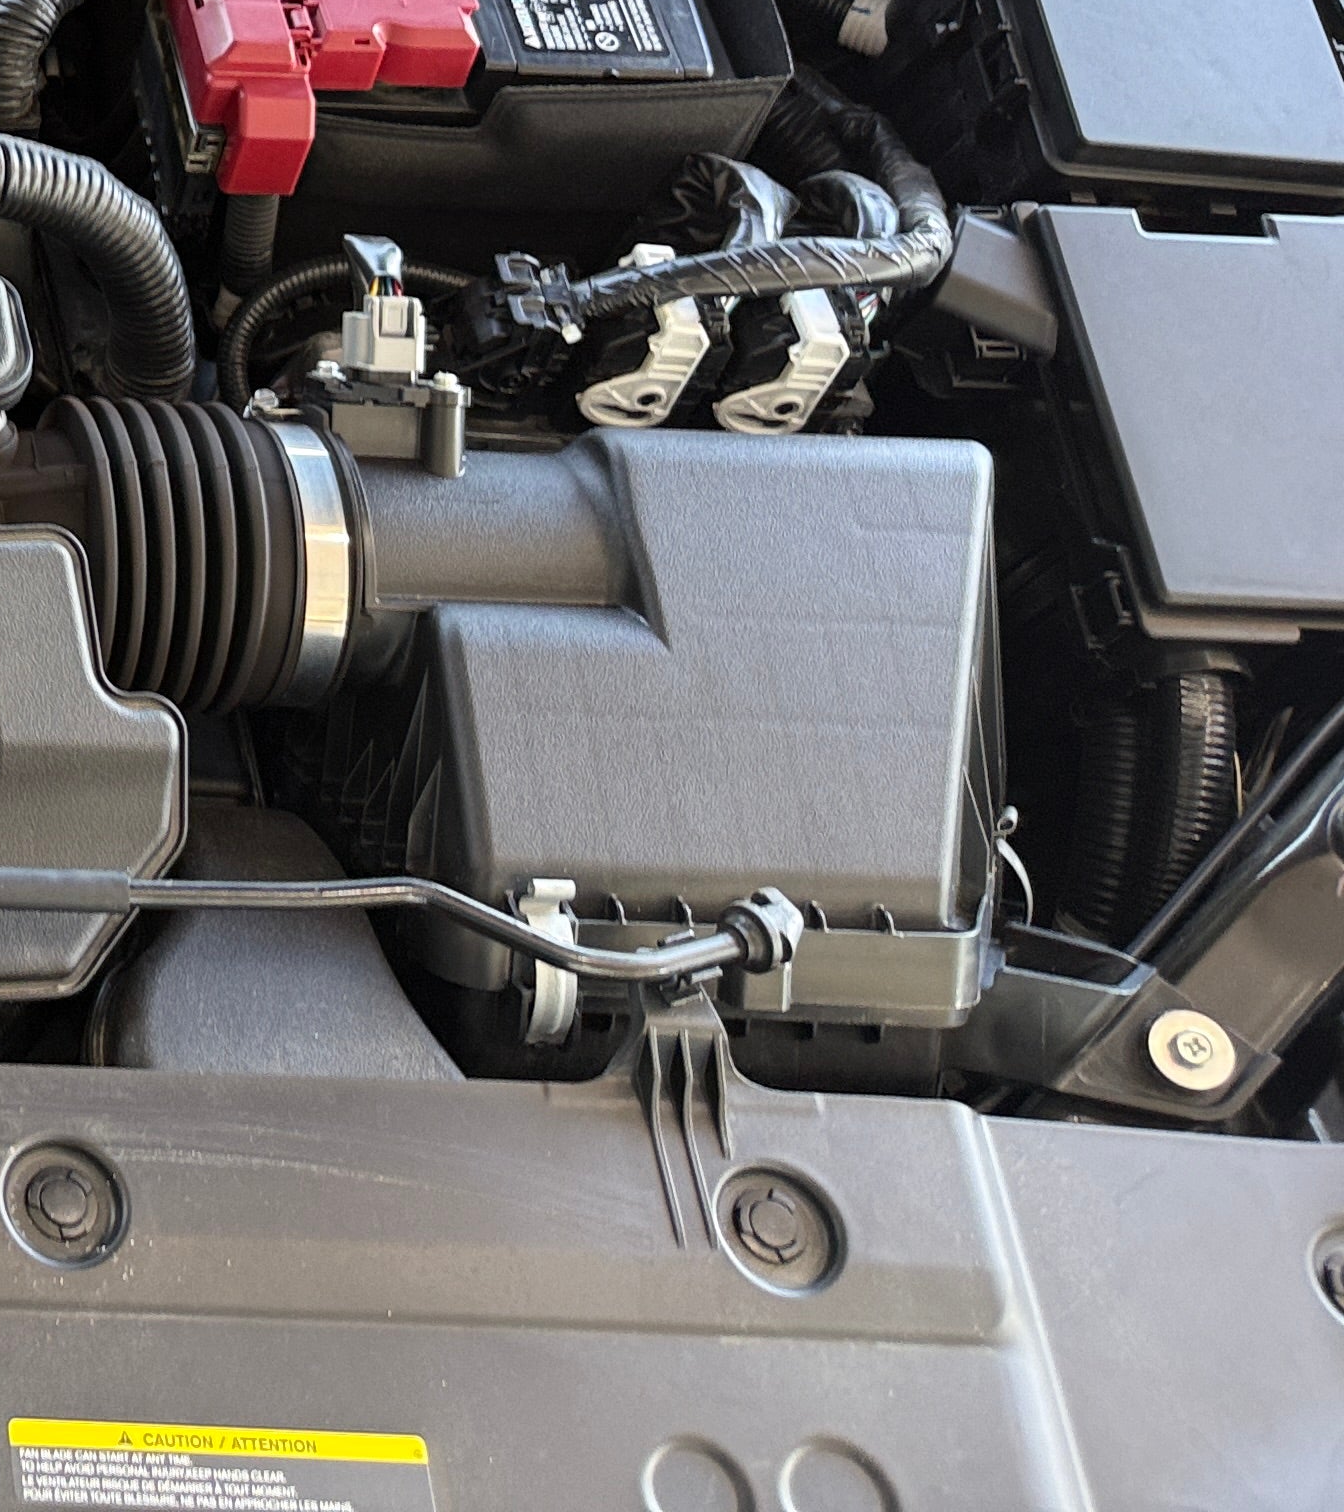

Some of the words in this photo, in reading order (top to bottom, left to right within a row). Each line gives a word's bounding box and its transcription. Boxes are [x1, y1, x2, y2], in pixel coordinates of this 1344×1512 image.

[143, 1432, 214, 1449] CAUTION
[231, 1436, 318, 1454] ATTENTION
[75, 1450, 97, 1461] CAN
